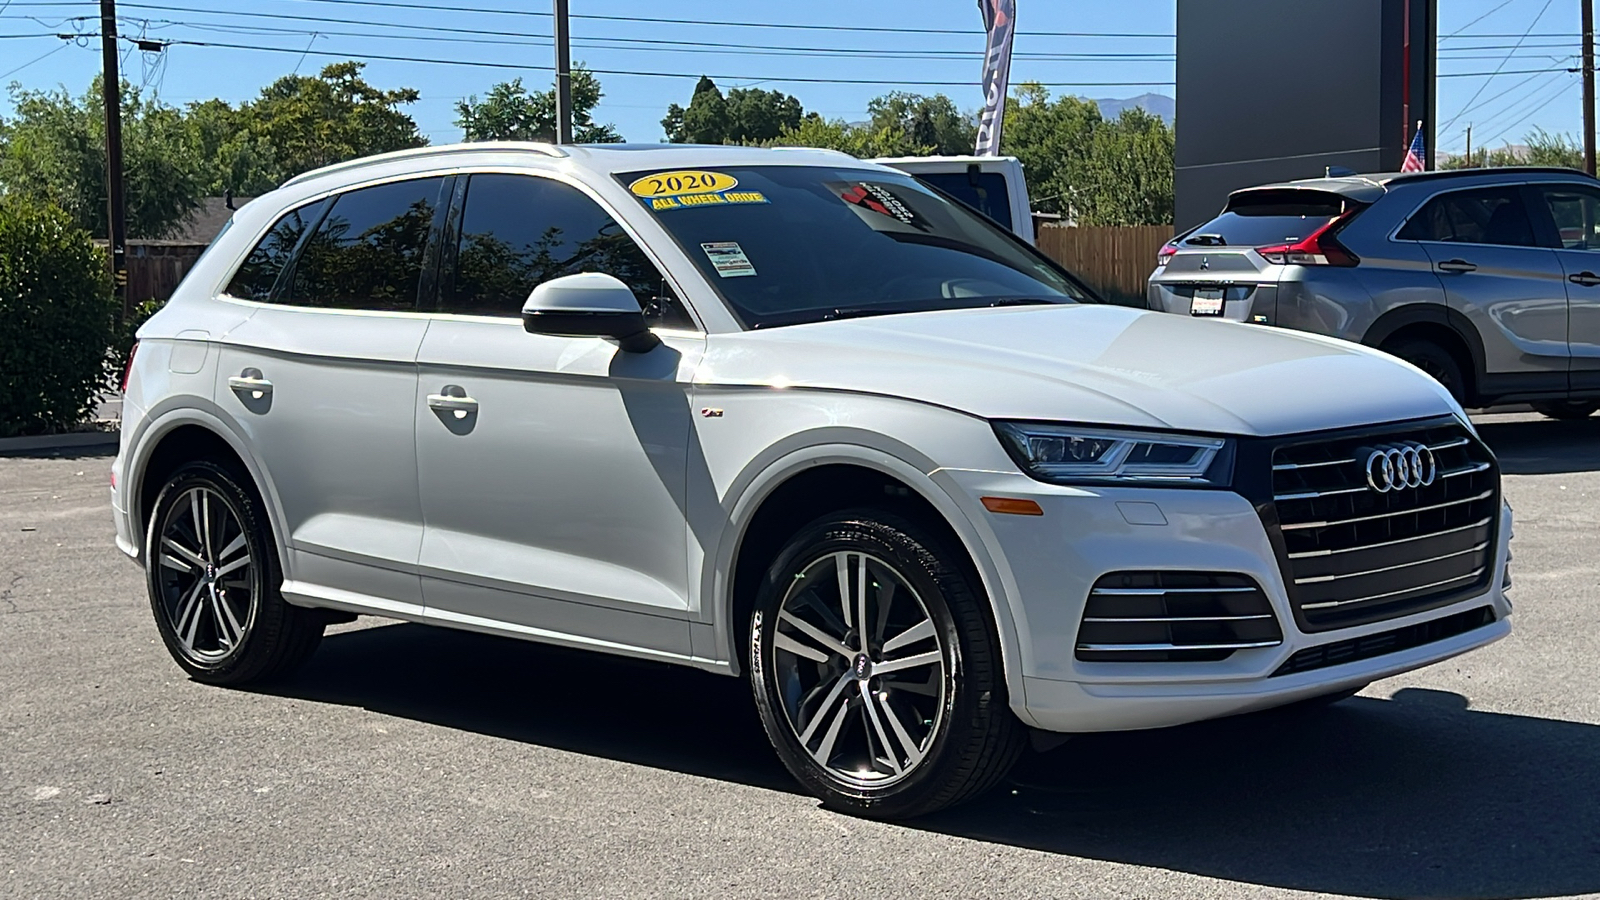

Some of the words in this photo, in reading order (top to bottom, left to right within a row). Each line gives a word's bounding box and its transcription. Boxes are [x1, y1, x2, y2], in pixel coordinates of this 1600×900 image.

[649, 173, 716, 194] 2020
[652, 197, 680, 210] ALL
[678, 194, 726, 206] WHEEL
[724, 192, 766, 203] DRIVE
